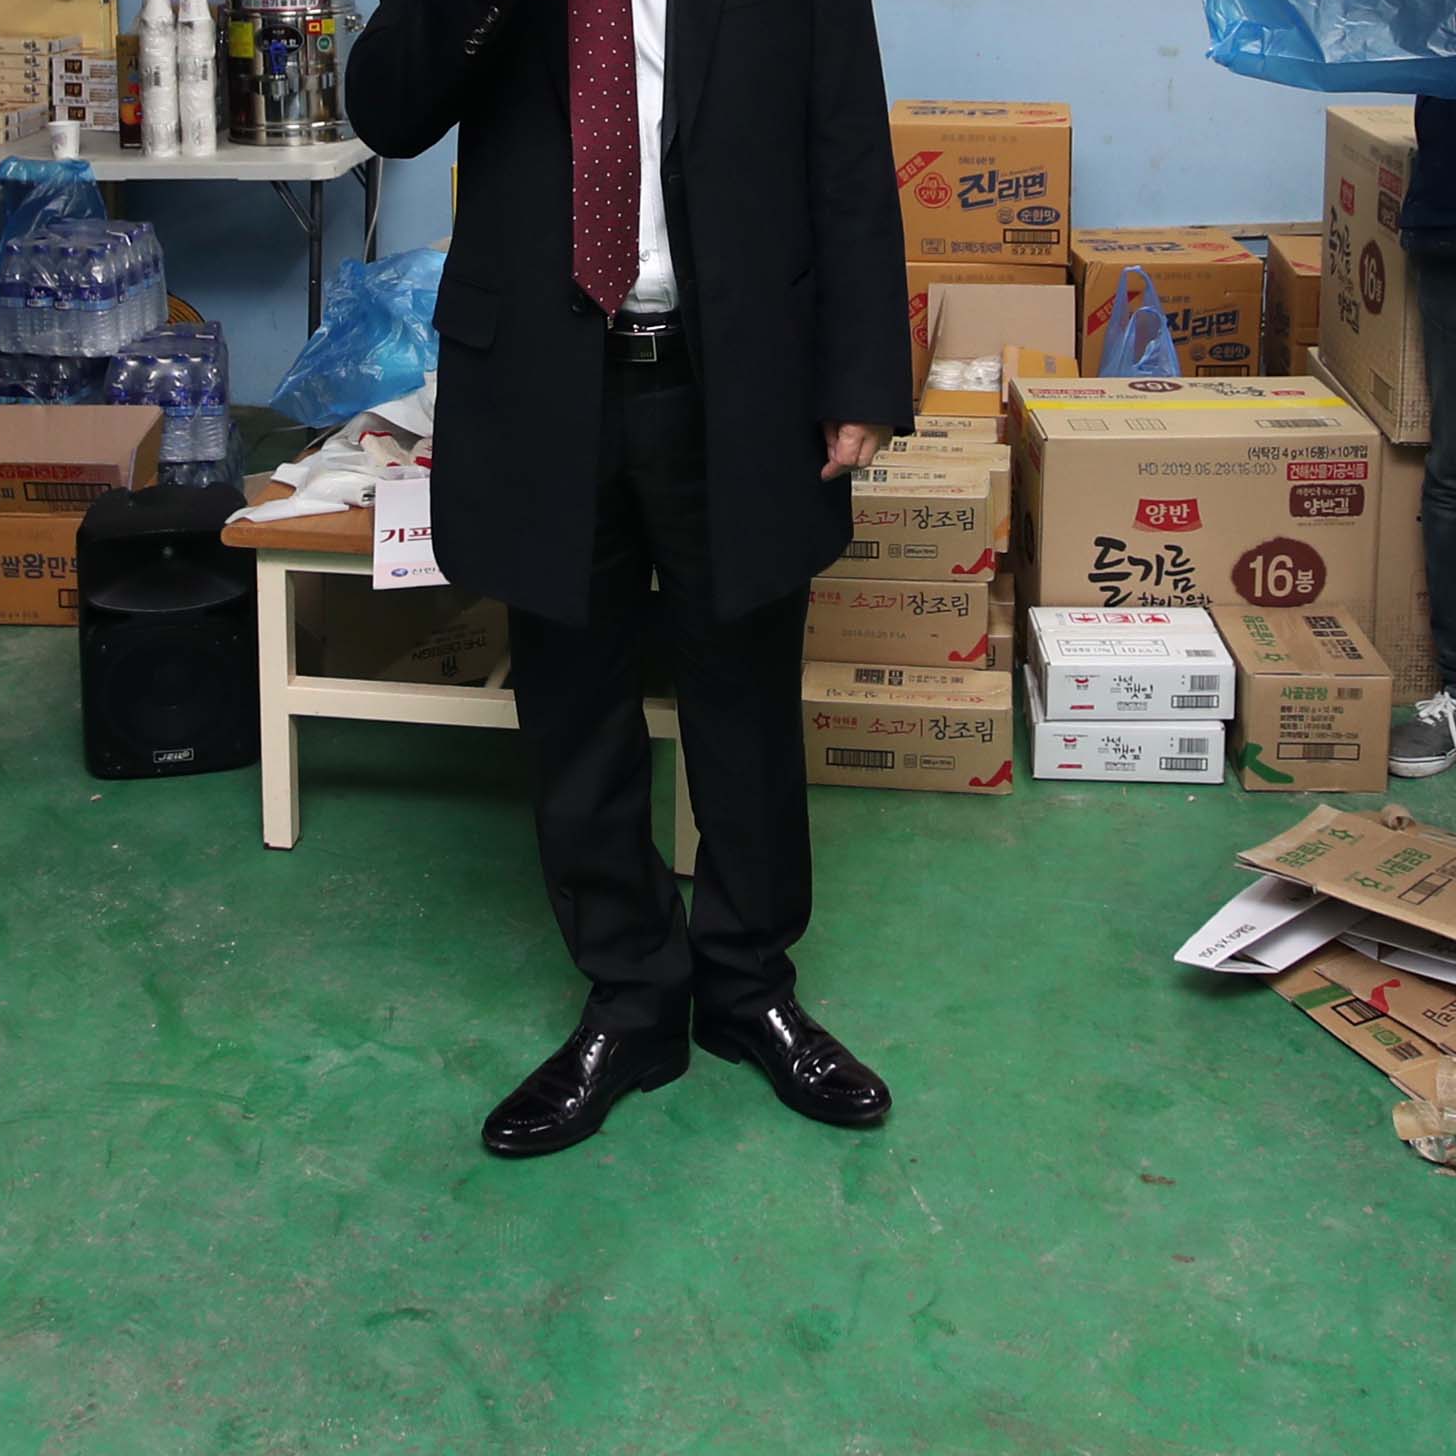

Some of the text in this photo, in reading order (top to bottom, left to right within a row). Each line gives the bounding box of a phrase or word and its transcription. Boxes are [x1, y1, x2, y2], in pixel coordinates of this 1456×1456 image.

[958, 170, 1049, 210] 진라면
[912, 506, 975, 531] 장조림
[1145, 503, 1191, 525] 양반
[1304, 497, 1349, 515] 양반김
[1249, 554, 1315, 598] 16봉
[907, 592, 970, 617] 장조림
[928, 715, 994, 743] 장조림
